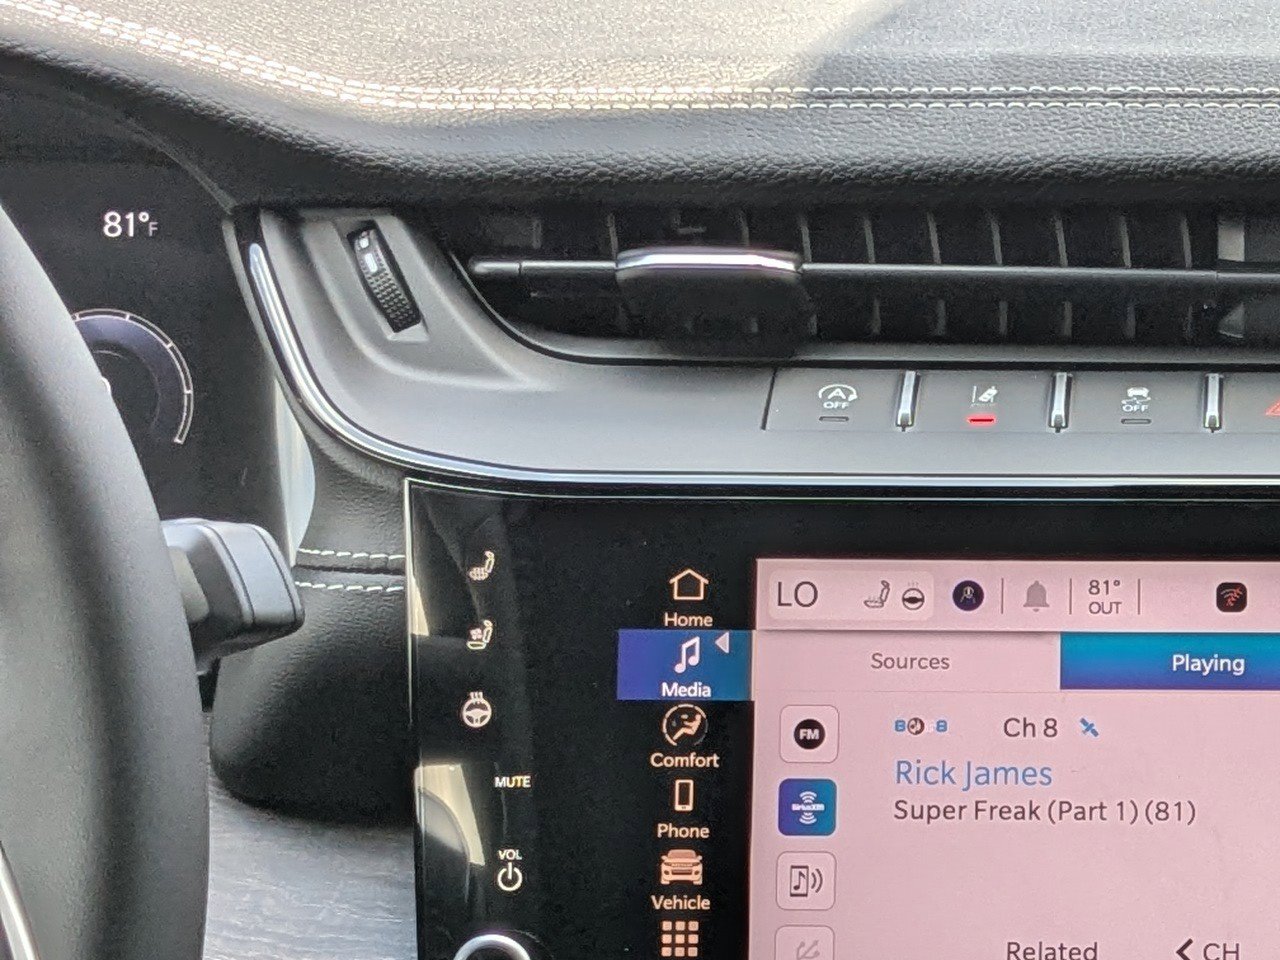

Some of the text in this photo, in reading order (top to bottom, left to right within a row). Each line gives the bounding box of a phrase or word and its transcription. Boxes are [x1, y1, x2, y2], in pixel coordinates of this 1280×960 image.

[777, 582, 818, 608] LO
[1088, 579, 1121, 597] 81°
[1088, 601, 1122, 615] OUT
[664, 612, 713, 627] Home
[871, 653, 950, 670] Sources
[1172, 654, 1245, 675] Playing
[662, 682, 711, 697] Media
[799, 729, 820, 740] FM
[1004, 718, 1058, 738] Ch 8
[650, 752, 719, 768] Comfort
[494, 776, 531, 788] MUTE
[896, 760, 1053, 791] Rick James
[894, 800, 1196, 825] Super Freak (Part 1) (81)
[657, 823, 710, 838] Phone
[498, 849, 522, 861] VOL
[651, 895, 711, 910] Vehicle
